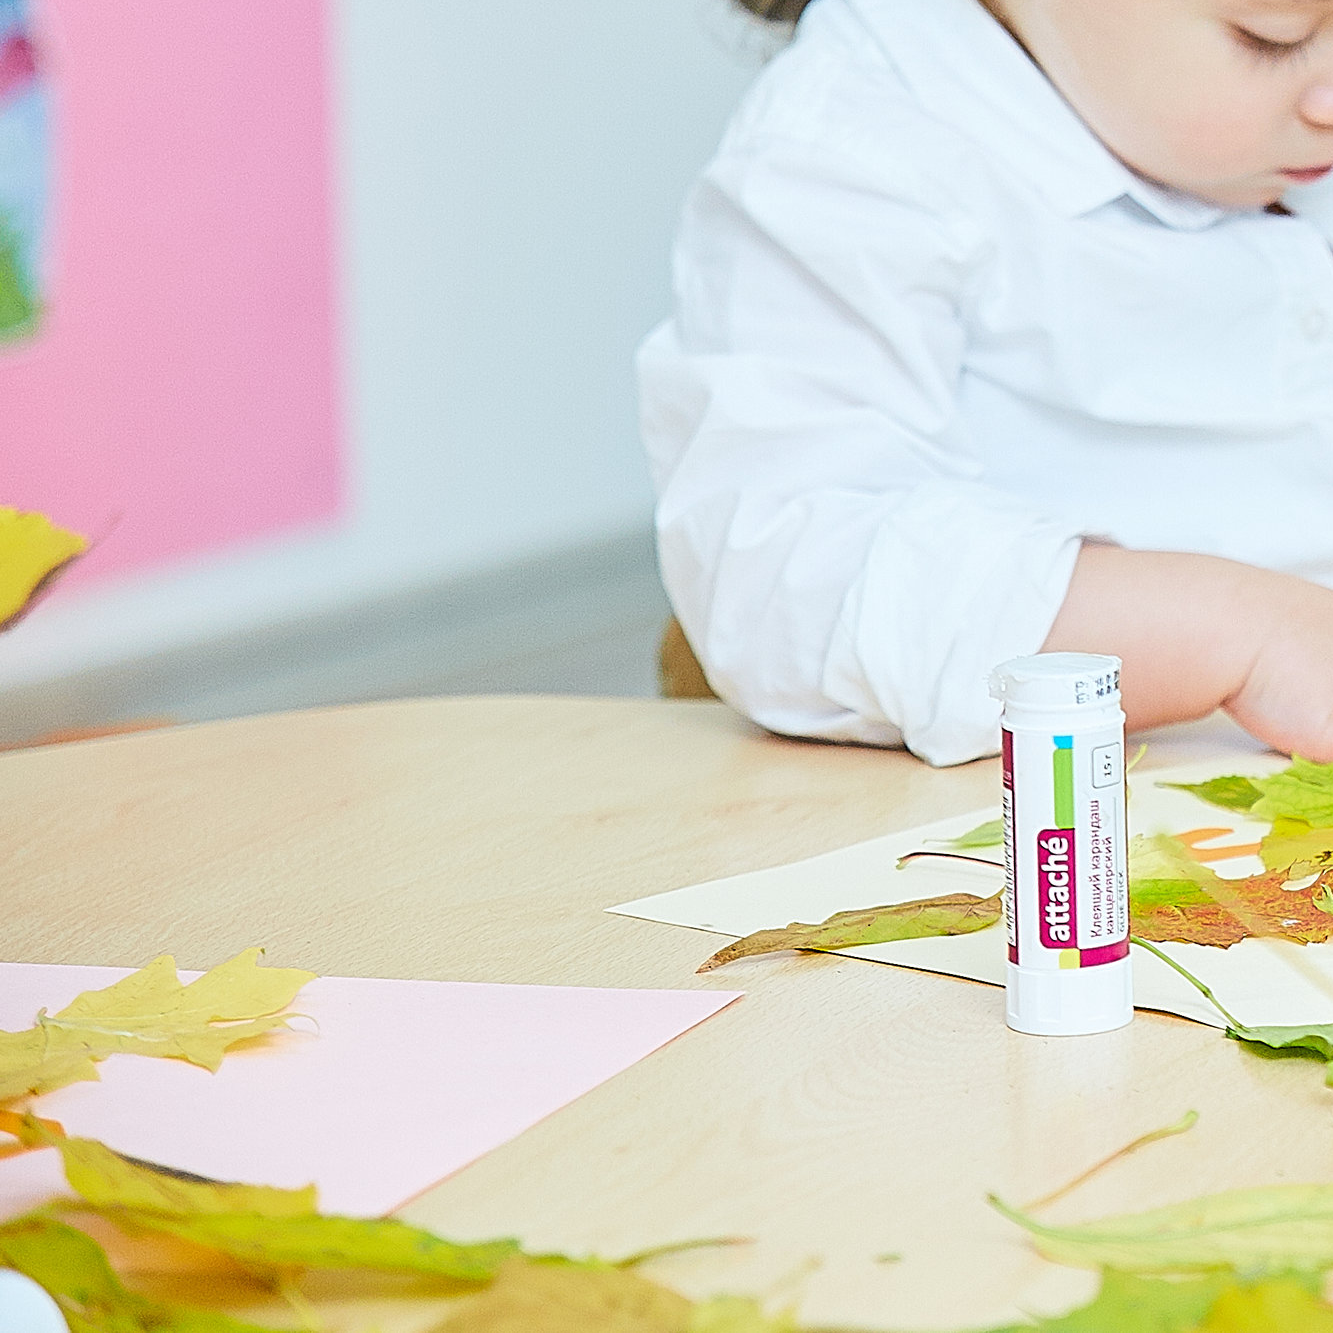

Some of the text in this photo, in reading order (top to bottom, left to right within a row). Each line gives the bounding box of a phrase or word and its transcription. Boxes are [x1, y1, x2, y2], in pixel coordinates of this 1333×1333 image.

[1104, 763, 1112, 778] 15
[1040, 837, 1070, 942] attaché
[1089, 800, 1102, 937] Клеящий карандаш
[1103, 837, 1114, 935] канцелярский
